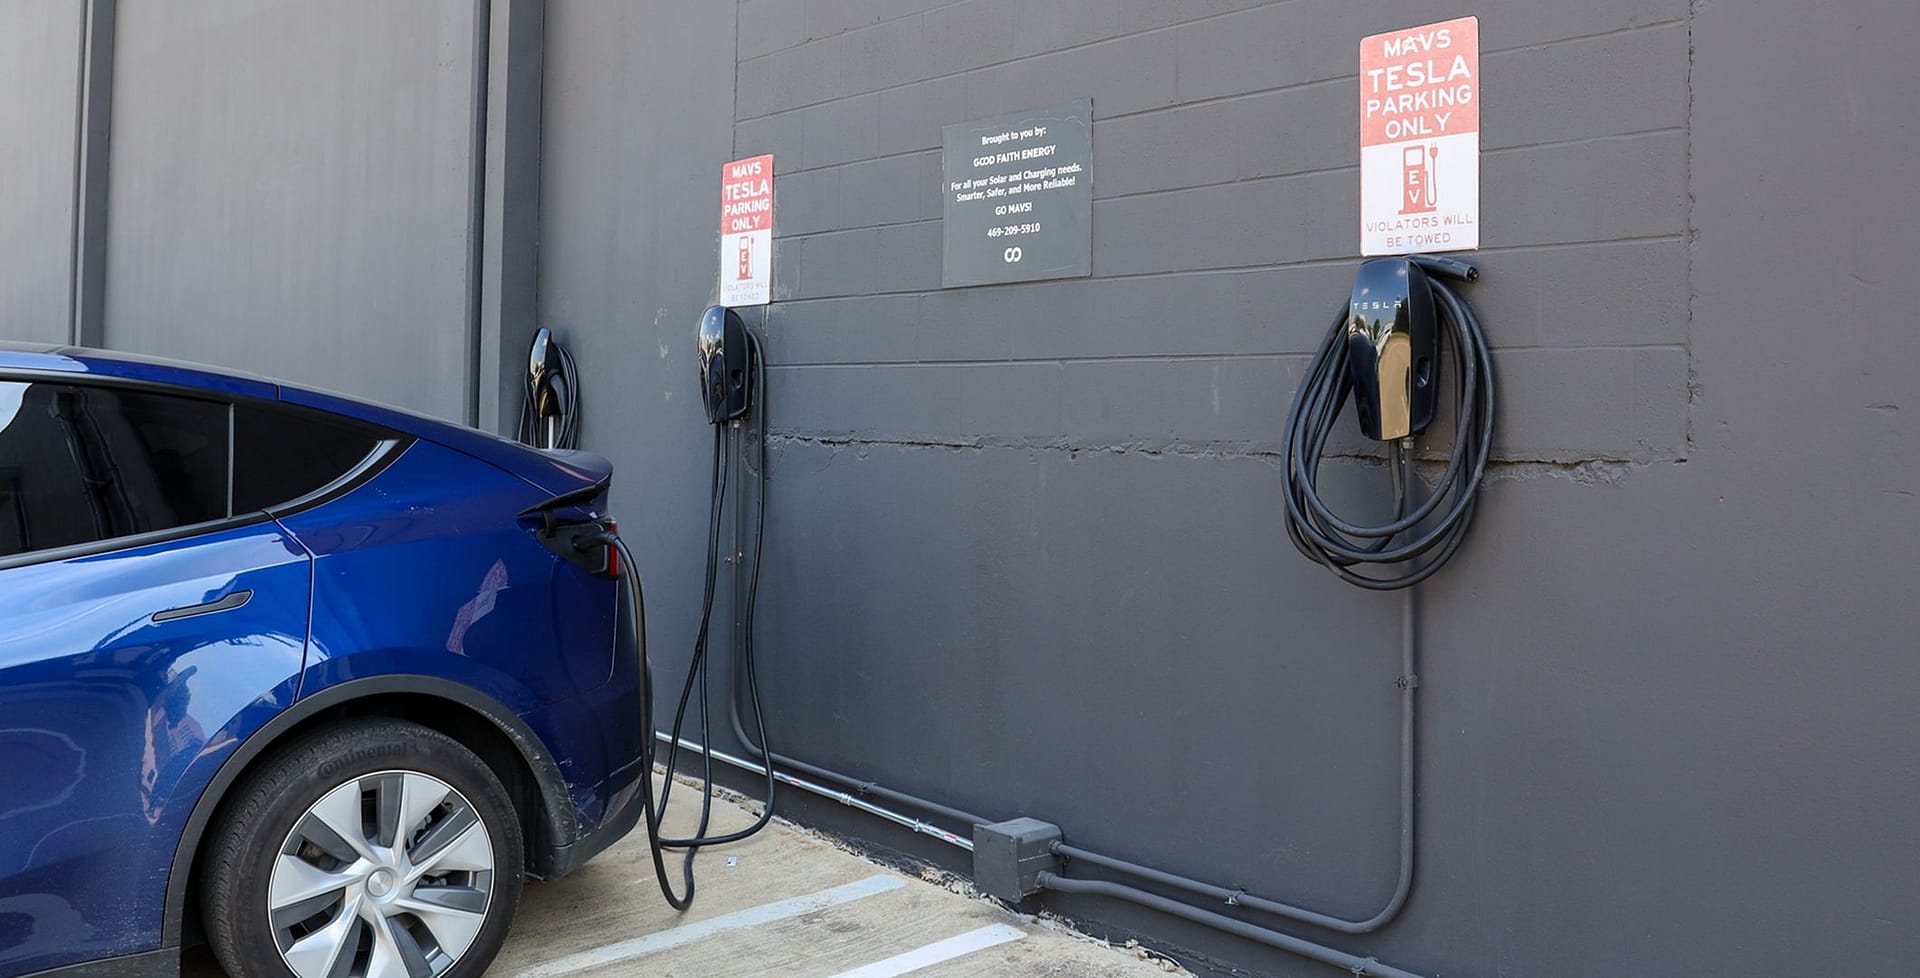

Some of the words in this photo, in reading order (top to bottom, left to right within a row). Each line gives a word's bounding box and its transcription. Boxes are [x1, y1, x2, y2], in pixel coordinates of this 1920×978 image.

[1383, 29, 1452, 58] MAVS
[1367, 55, 1471, 93] TESLA
[1366, 85, 1472, 118] PARKING
[981, 131, 1010, 145] Brought
[1011, 131, 1019, 141] to
[1020, 129, 1034, 142] you
[1034, 126, 1047, 138] by:
[1385, 112, 1452, 139] ONLY
[973, 155, 995, 168] GOOD
[996, 151, 1021, 165] FAITH
[1021, 145, 1057, 160] ENERGY
[731, 161, 762, 178] MAVS
[951, 182, 962, 192] For
[962, 180, 972, 190] all
[972, 178, 988, 190] your
[988, 175, 1008, 186] Solar
[1008, 172, 1022, 183] and
[1023, 167, 1056, 180] Charging
[1057, 163, 1083, 175] needs.
[725, 178, 770, 201] TESLA
[956, 191, 985, 202] Smarter,
[986, 187, 1007, 198] Safer,
[1008, 183, 1022, 195] and
[1023, 182, 1043, 193] More
[1043, 176, 1076, 190] Reliable!
[724, 198, 770, 217] PARKING
[995, 205, 1007, 216] GO
[1008, 201, 1033, 215] MAVS!
[731, 215, 761, 232] ONLY
[987, 222, 1041, 238] 469-209-5910
[1366, 216, 1439, 233] VIOLATORS
[1442, 213, 1473, 226] WILL
[1386, 236, 1402, 248] BE
[1407, 232, 1451, 246] TOWED
[1353, 300, 1402, 310] TESLA
